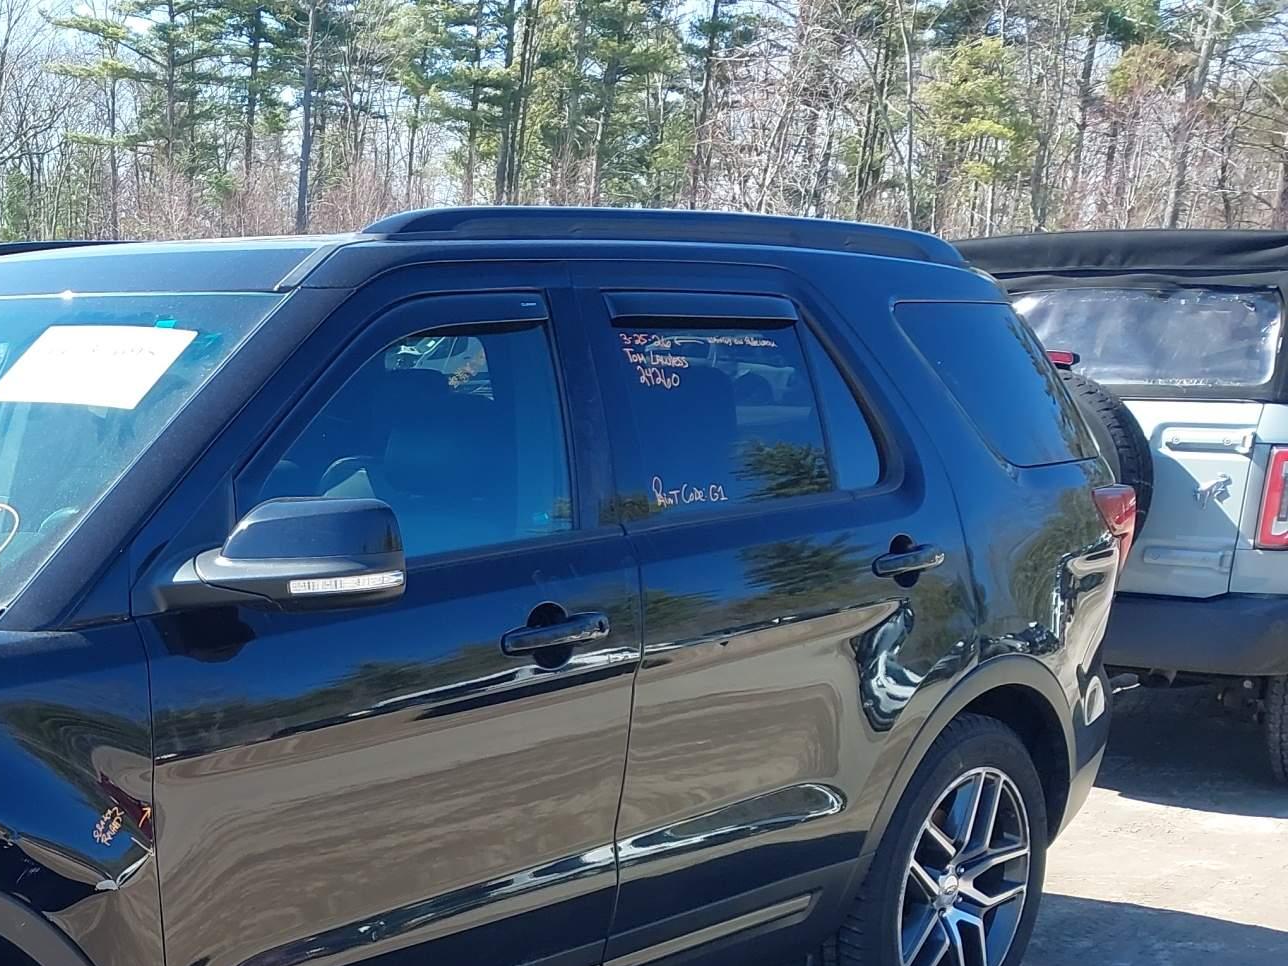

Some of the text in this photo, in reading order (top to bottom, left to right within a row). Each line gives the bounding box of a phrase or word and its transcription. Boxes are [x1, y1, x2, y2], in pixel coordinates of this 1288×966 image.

[619, 333, 672, 349] 3-25-26
[636, 365, 680, 389] 24260
[709, 484, 729, 502] G1
